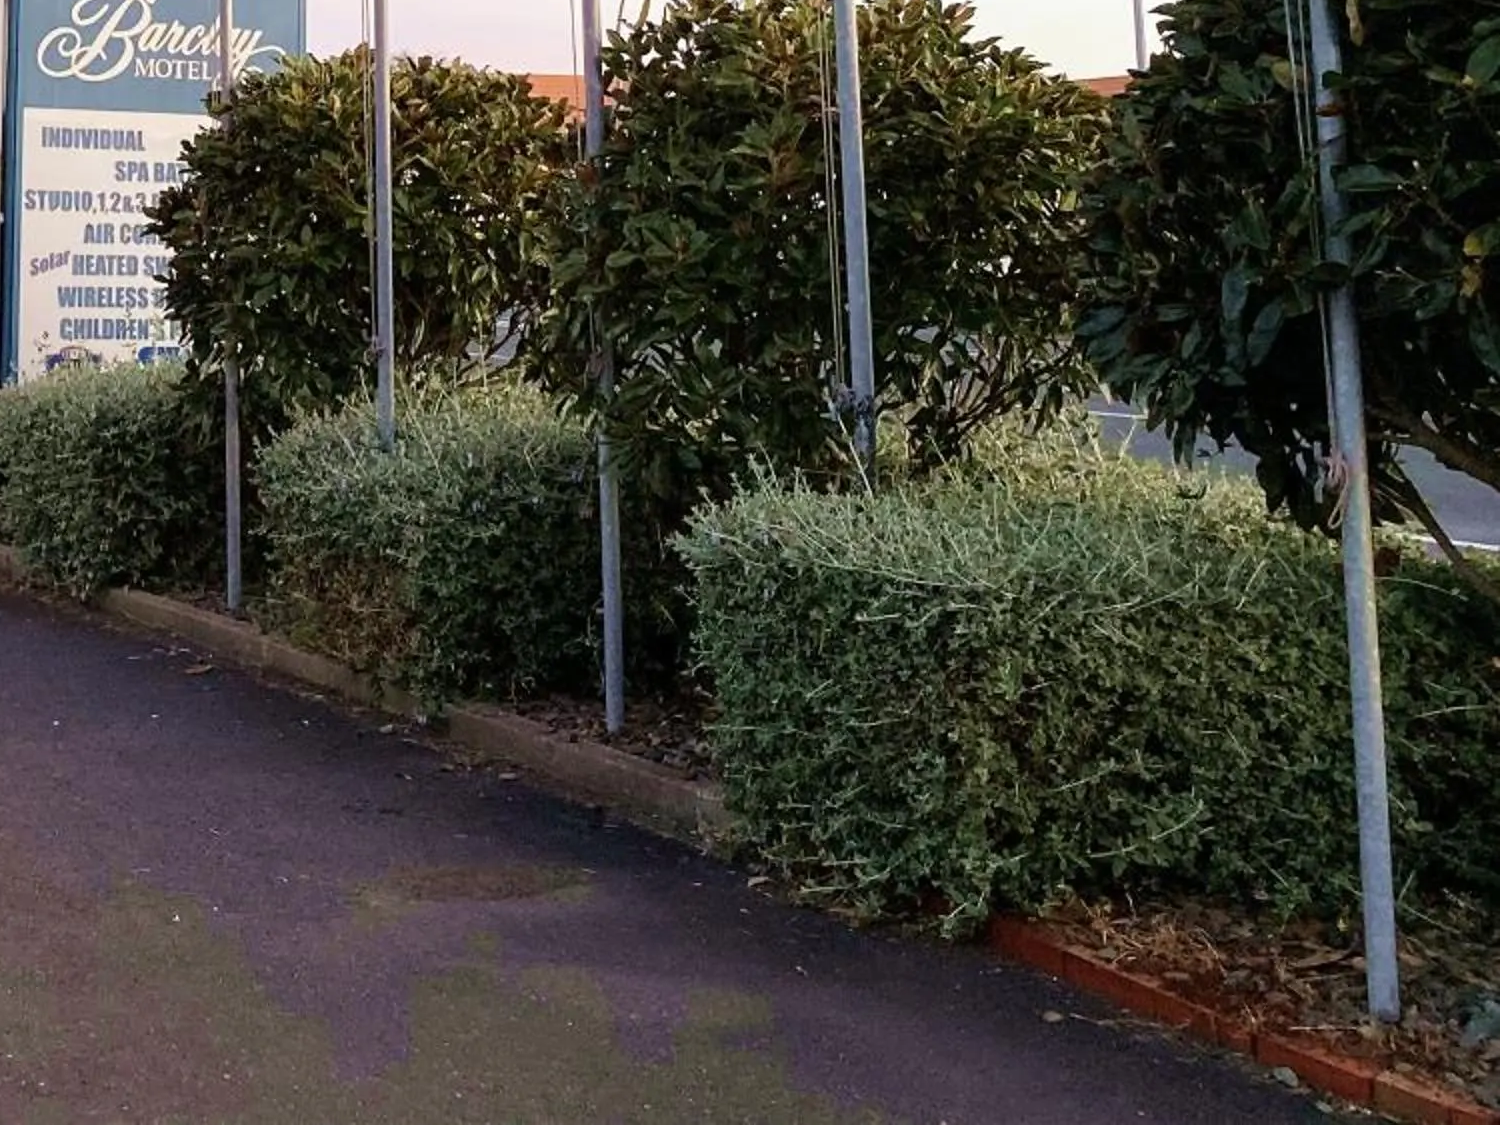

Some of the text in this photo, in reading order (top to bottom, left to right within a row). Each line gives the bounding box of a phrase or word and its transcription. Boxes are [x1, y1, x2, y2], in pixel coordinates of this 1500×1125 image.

[134, 58, 212, 80] MOTEL
[41, 126, 146, 151] INDIVIDUAL
[115, 161, 148, 183] SPA
[83, 223, 115, 244] AIR
[30, 250, 71, 277] Solar
[72, 254, 139, 277] HEATED
[57, 286, 149, 309] WIRELESS
